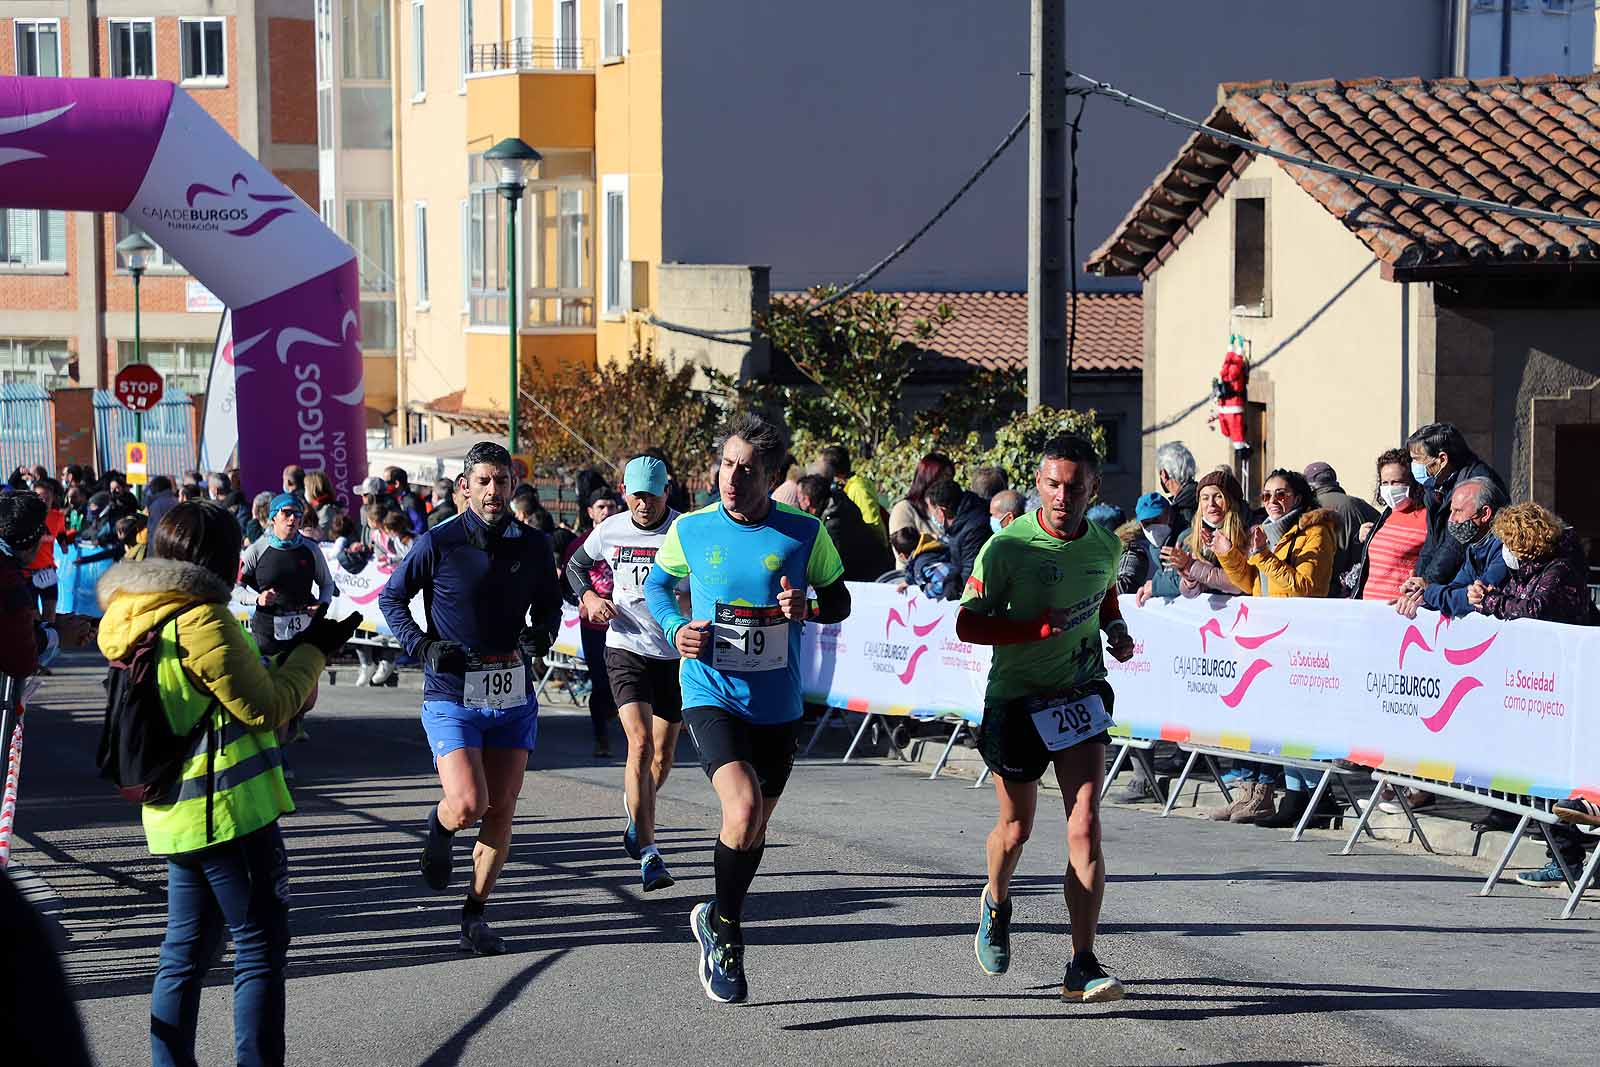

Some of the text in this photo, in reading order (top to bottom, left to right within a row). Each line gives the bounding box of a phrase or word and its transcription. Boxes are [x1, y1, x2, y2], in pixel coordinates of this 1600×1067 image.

[168, 222, 219, 231] FUNDACIÓN
[120, 381, 158, 393] STOP
[294, 363, 326, 473] URGOS
[331, 431, 350, 516] DACIÓN
[632, 565, 653, 585] 12
[288, 617, 302, 631] 43
[740, 630, 765, 655] 19
[1124, 661, 1151, 676] proyecto
[1173, 656, 1237, 679] CAJADEBURGOS
[1288, 651, 1330, 668] La Sociedad
[483, 672, 513, 696] 198
[1187, 681, 1218, 695] FUNDACIÓN
[1289, 673, 1340, 693] como proyecto
[1366, 672, 1440, 699] CAJADEBURGOS
[1505, 668, 1555, 692] La Sociedad
[1382, 701, 1419, 716] FUNDACIÓN
[1504, 695, 1565, 719] como proyecto
[1052, 704, 1092, 734] 208
